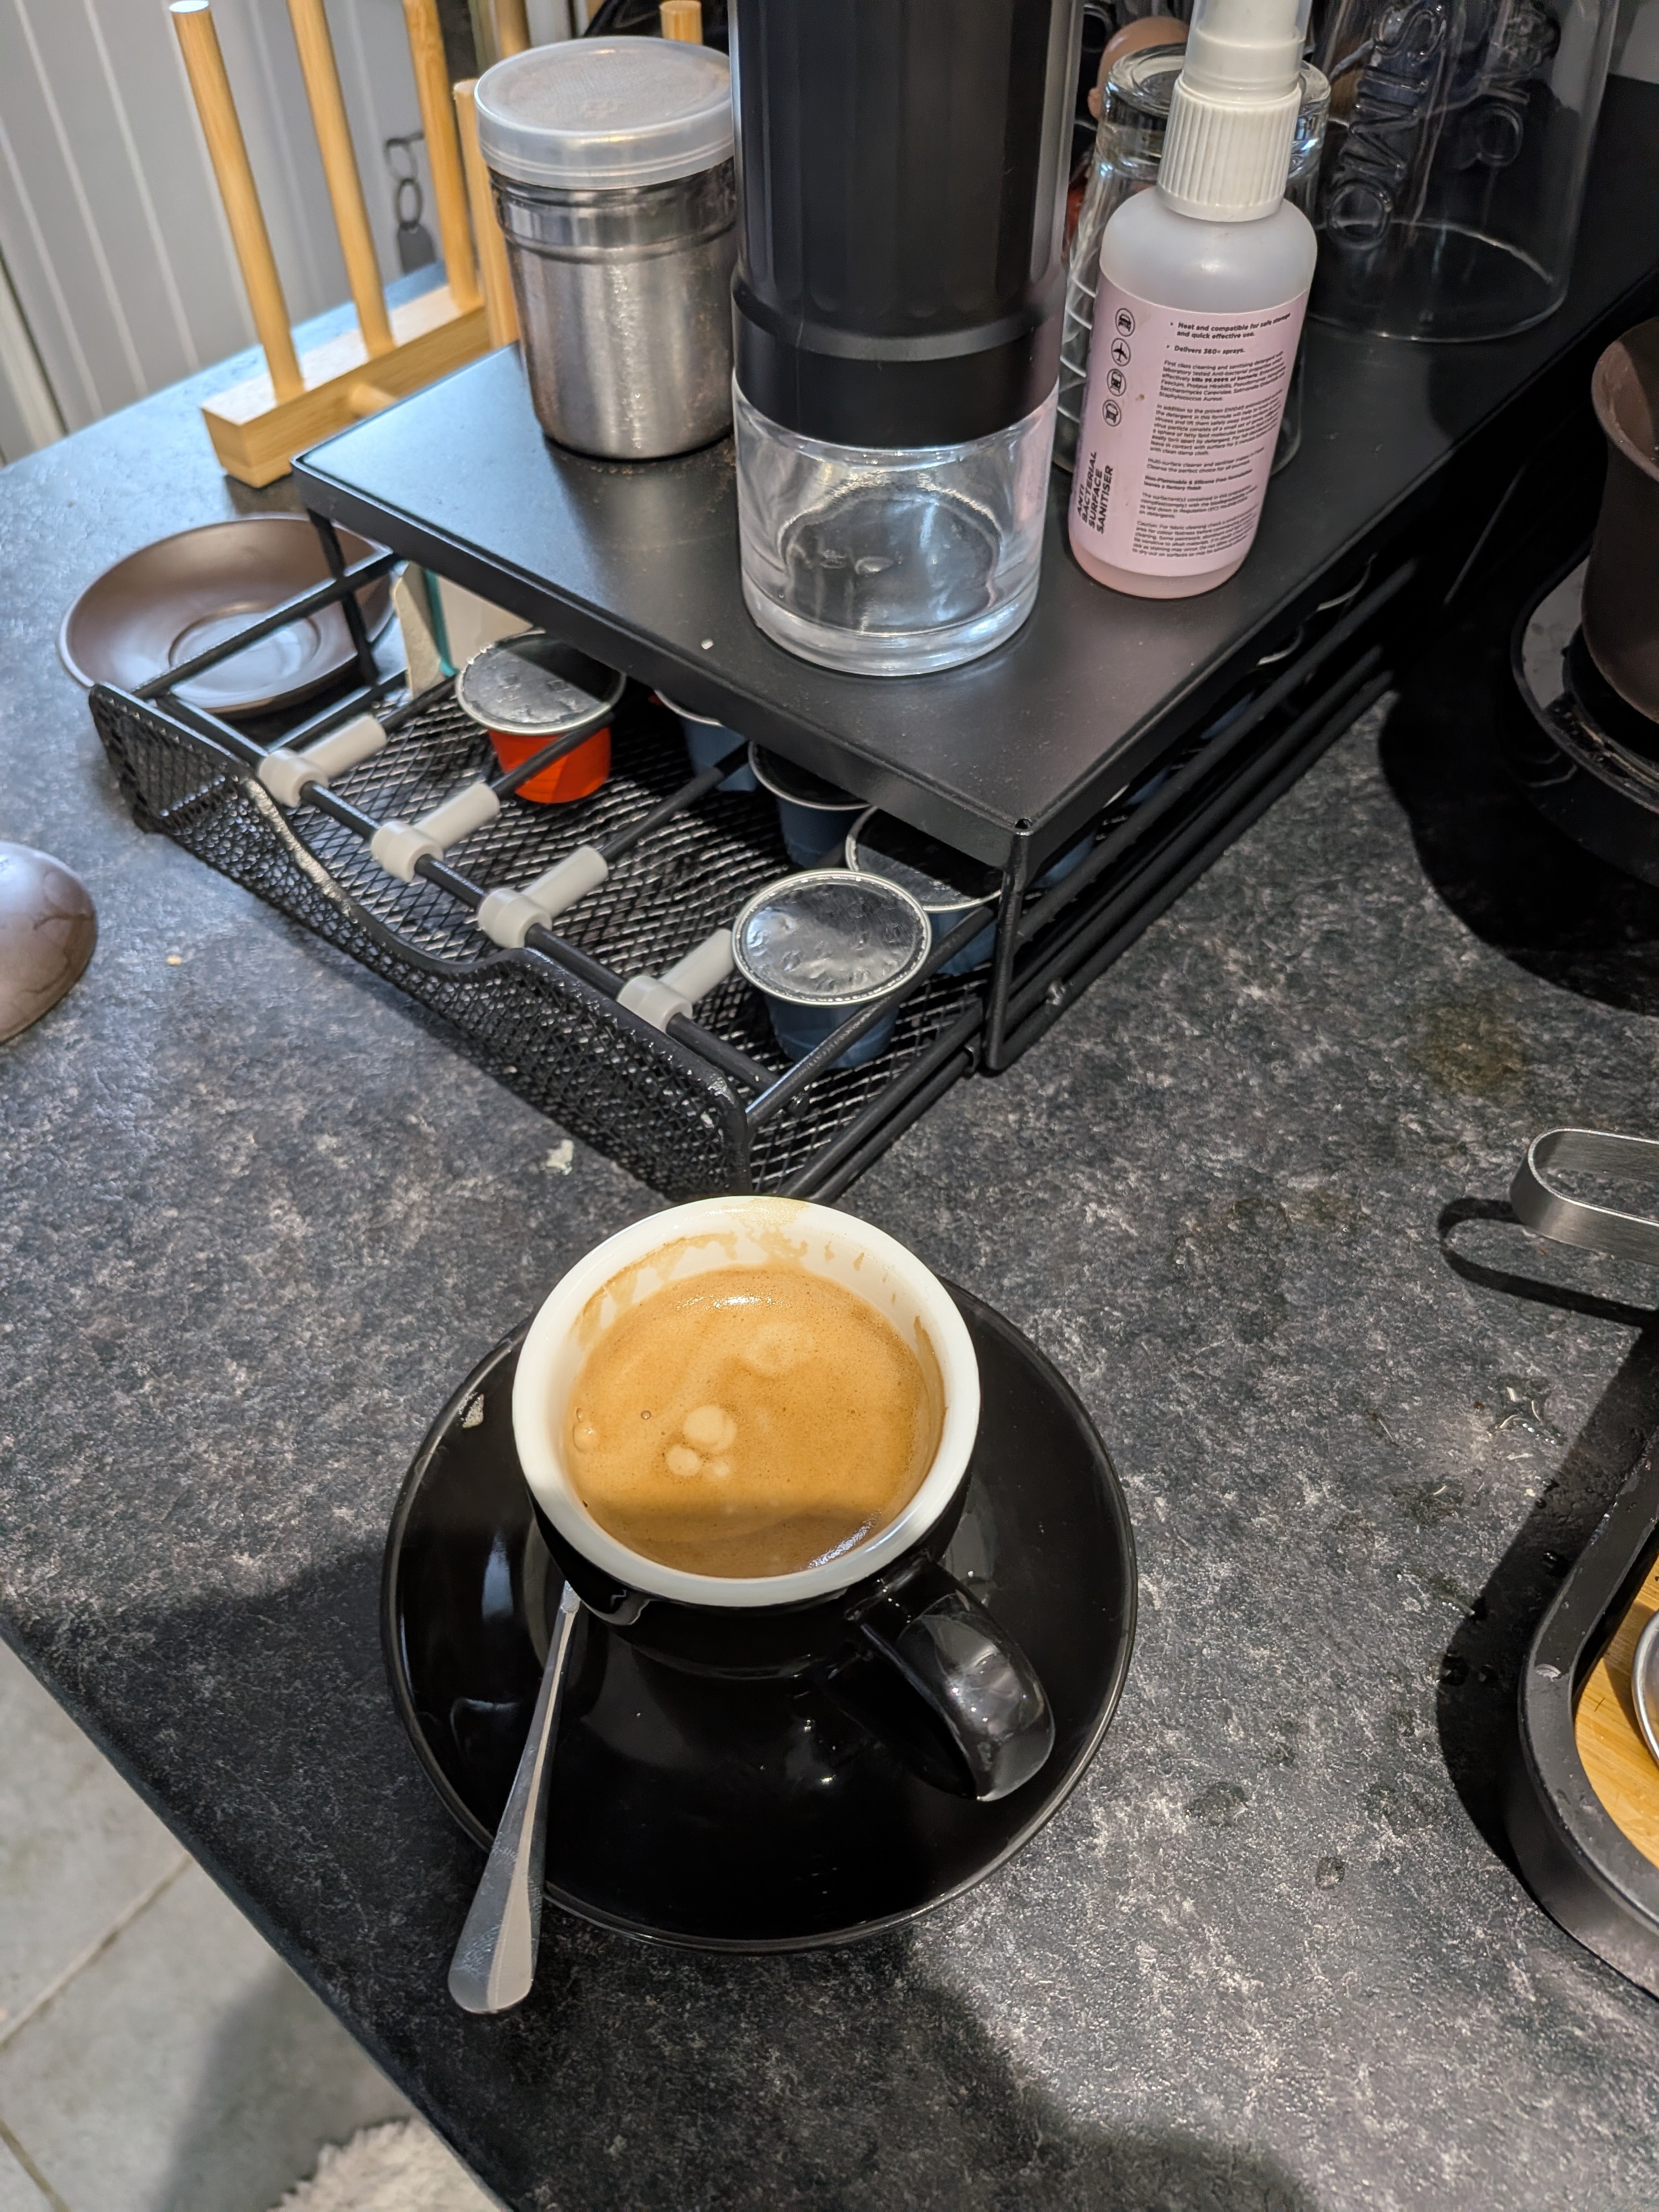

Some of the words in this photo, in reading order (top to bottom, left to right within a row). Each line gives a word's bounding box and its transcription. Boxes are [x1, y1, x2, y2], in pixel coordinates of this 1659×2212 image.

[1174, 345, 1202, 354] Delivers
[1178, 322, 1194, 330] Neat
[1260, 320, 1272, 328] safe
[1082, 451, 1097, 523] BACTERIAL
[1088, 468, 1103, 529] SURFACE
[1096, 465, 1114, 535] SANITISER
